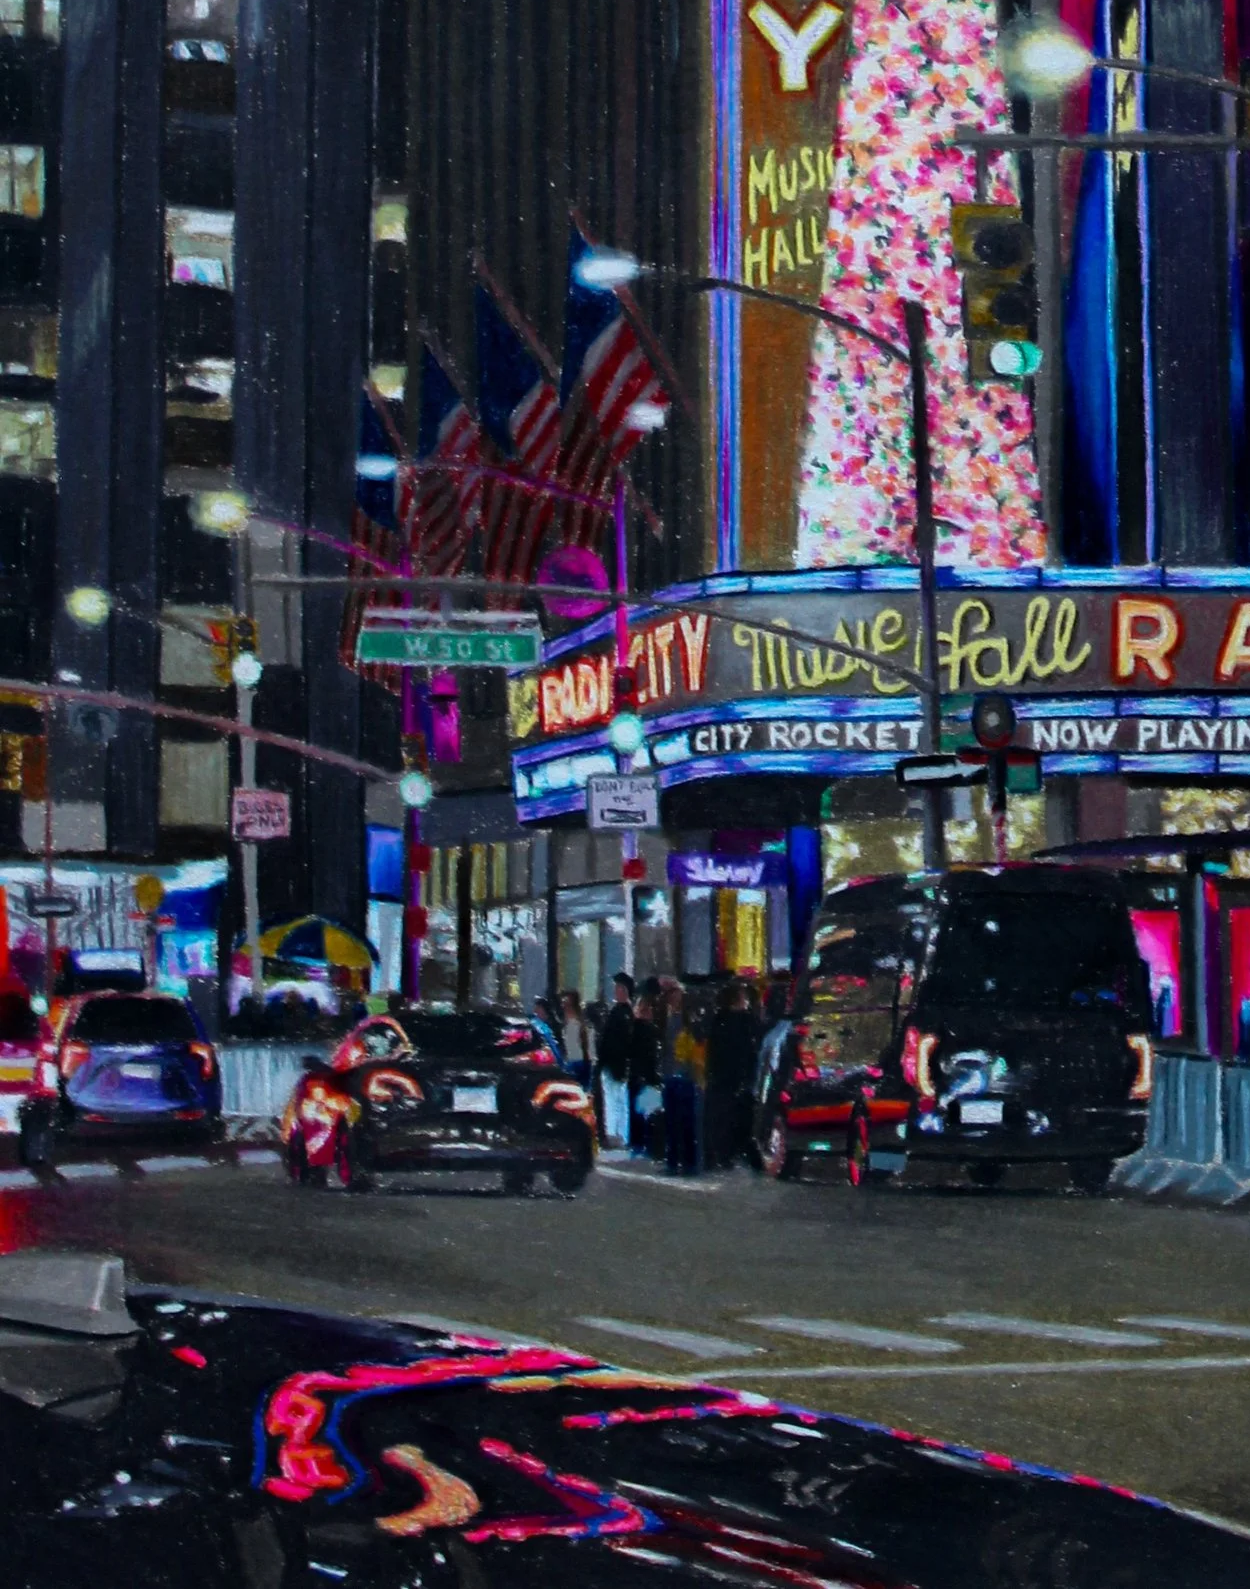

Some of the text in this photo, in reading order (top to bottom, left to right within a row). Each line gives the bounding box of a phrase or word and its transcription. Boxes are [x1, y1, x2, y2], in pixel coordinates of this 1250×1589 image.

[438, 638, 472, 660] 50
[485, 639, 514, 661] St
[540, 656, 618, 732] RADI
[733, 609, 910, 694] Music
[694, 722, 752, 752] CITY
[768, 721, 924, 751] ROCKET
[1032, 718, 1118, 751] NOW
